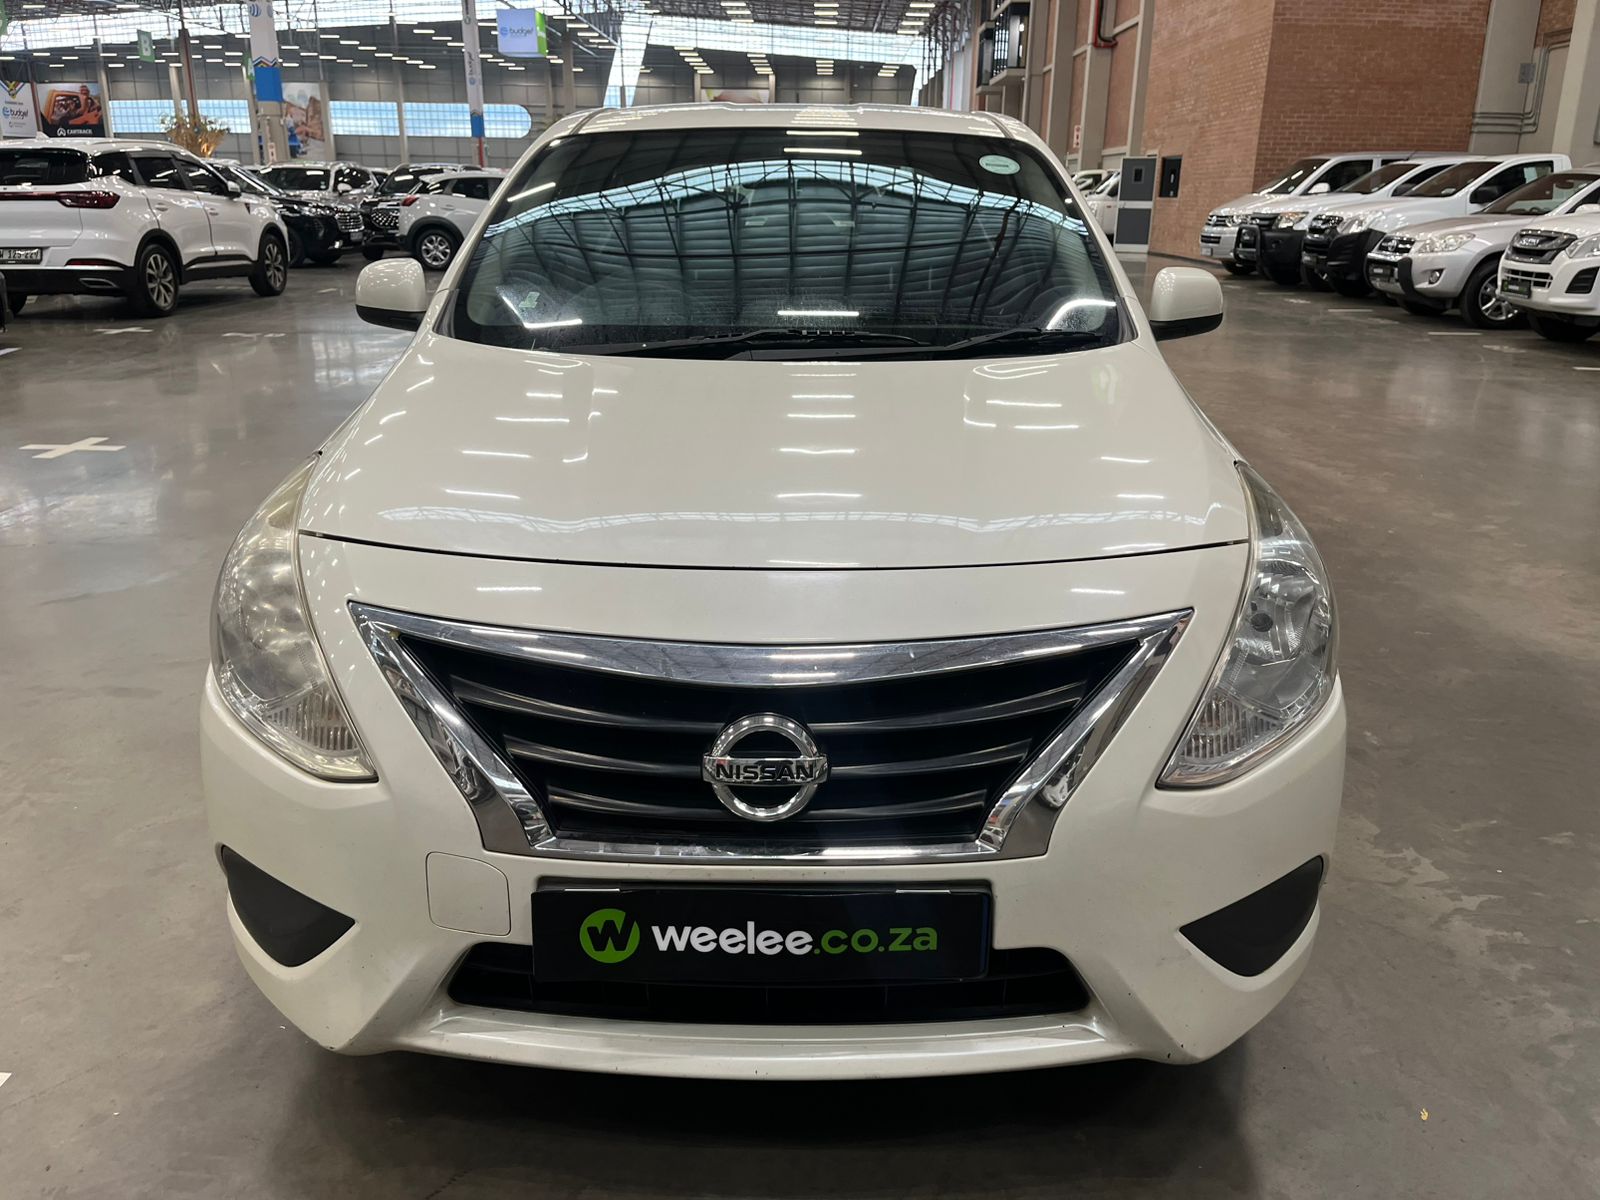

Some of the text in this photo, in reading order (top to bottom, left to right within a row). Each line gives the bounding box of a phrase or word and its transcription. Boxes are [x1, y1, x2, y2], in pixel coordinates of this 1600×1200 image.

[142, 34, 152, 56] B
[715, 763, 814, 780] NISSAN
[651, 921, 938, 955] weelee.co.za
